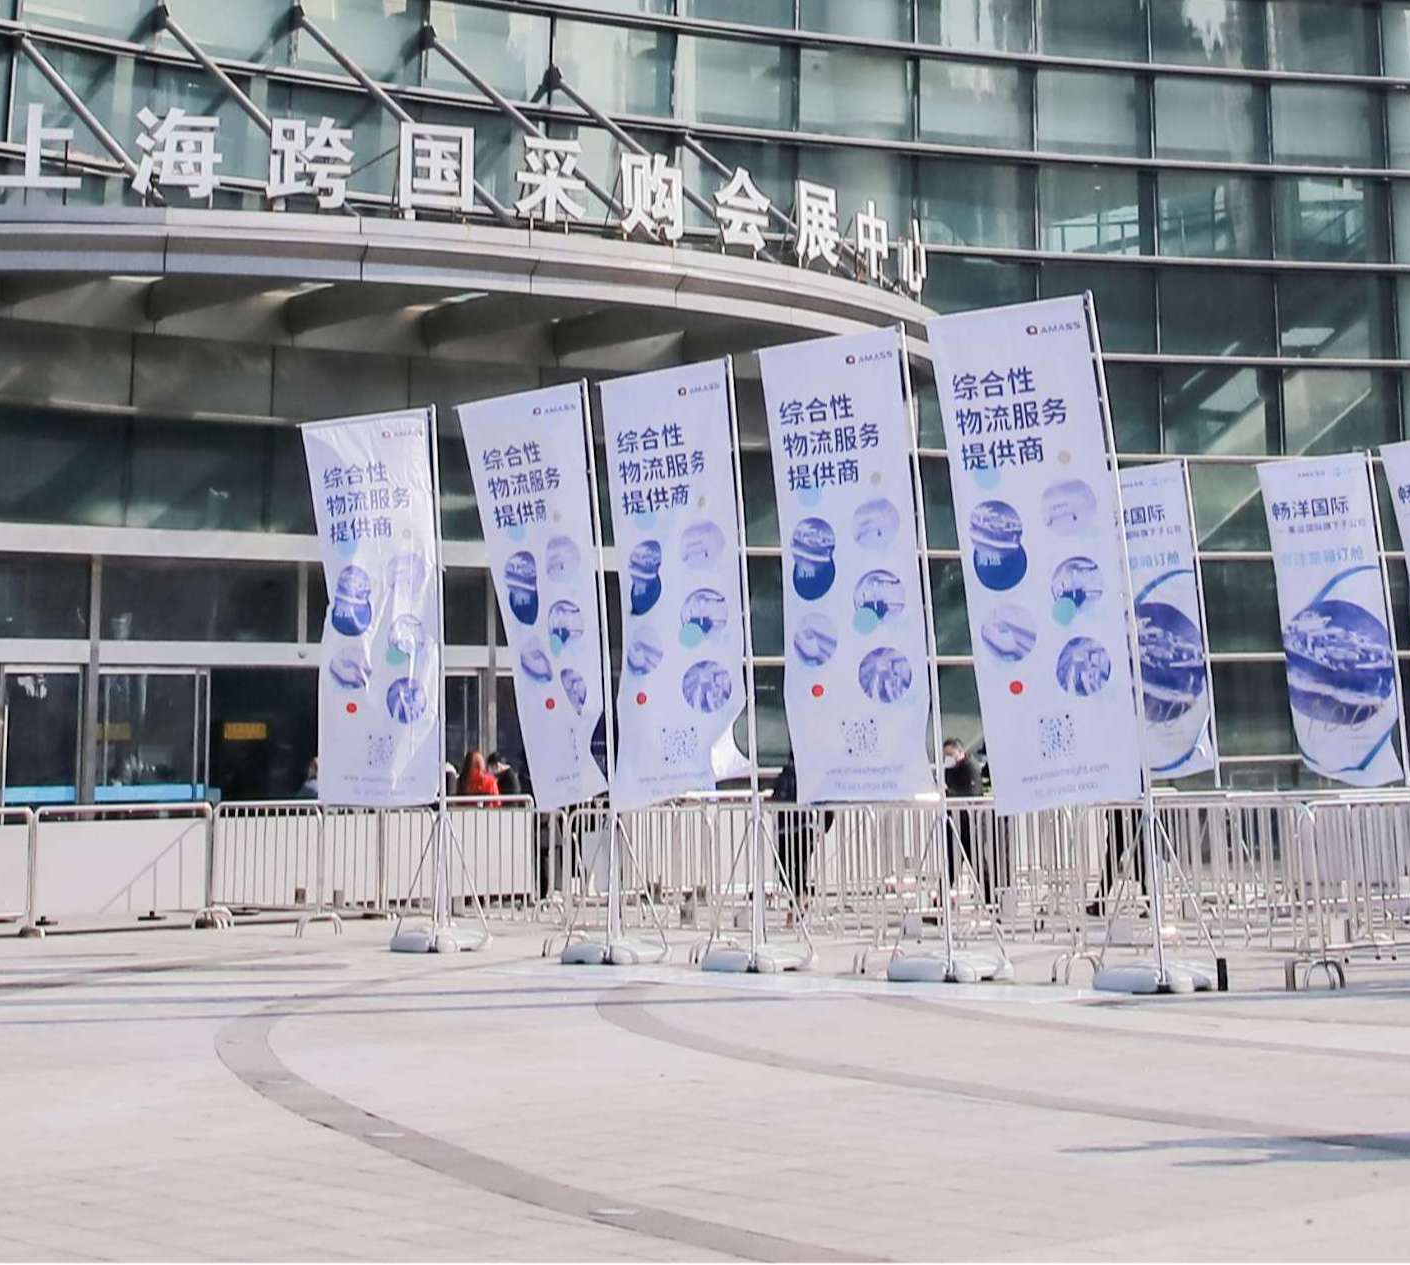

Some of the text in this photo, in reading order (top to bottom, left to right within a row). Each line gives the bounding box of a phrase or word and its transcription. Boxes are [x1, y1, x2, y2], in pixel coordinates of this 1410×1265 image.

[1041, 322, 1081, 334] AMASS
[952, 366, 1036, 401] 综合性
[779, 393, 854, 426] 综合性
[955, 398, 1067, 436] 物流服务
[616, 422, 684, 454] 综合性
[783, 422, 880, 459] 物流服务
[961, 436, 1044, 471] 提供商
[483, 440, 541, 471] 综合性
[619, 449, 706, 485] 物流服务
[323, 461, 388, 488] 综合性
[488, 466, 560, 500] 物流服务
[787, 459, 859, 491] 提供商
[326, 487, 410, 517] 物流服务
[493, 499, 547, 529] 提供商
[622, 484, 690, 516] 提供商
[1271, 496, 1349, 521] 畅洋国际
[330, 516, 392, 544] 提供商
